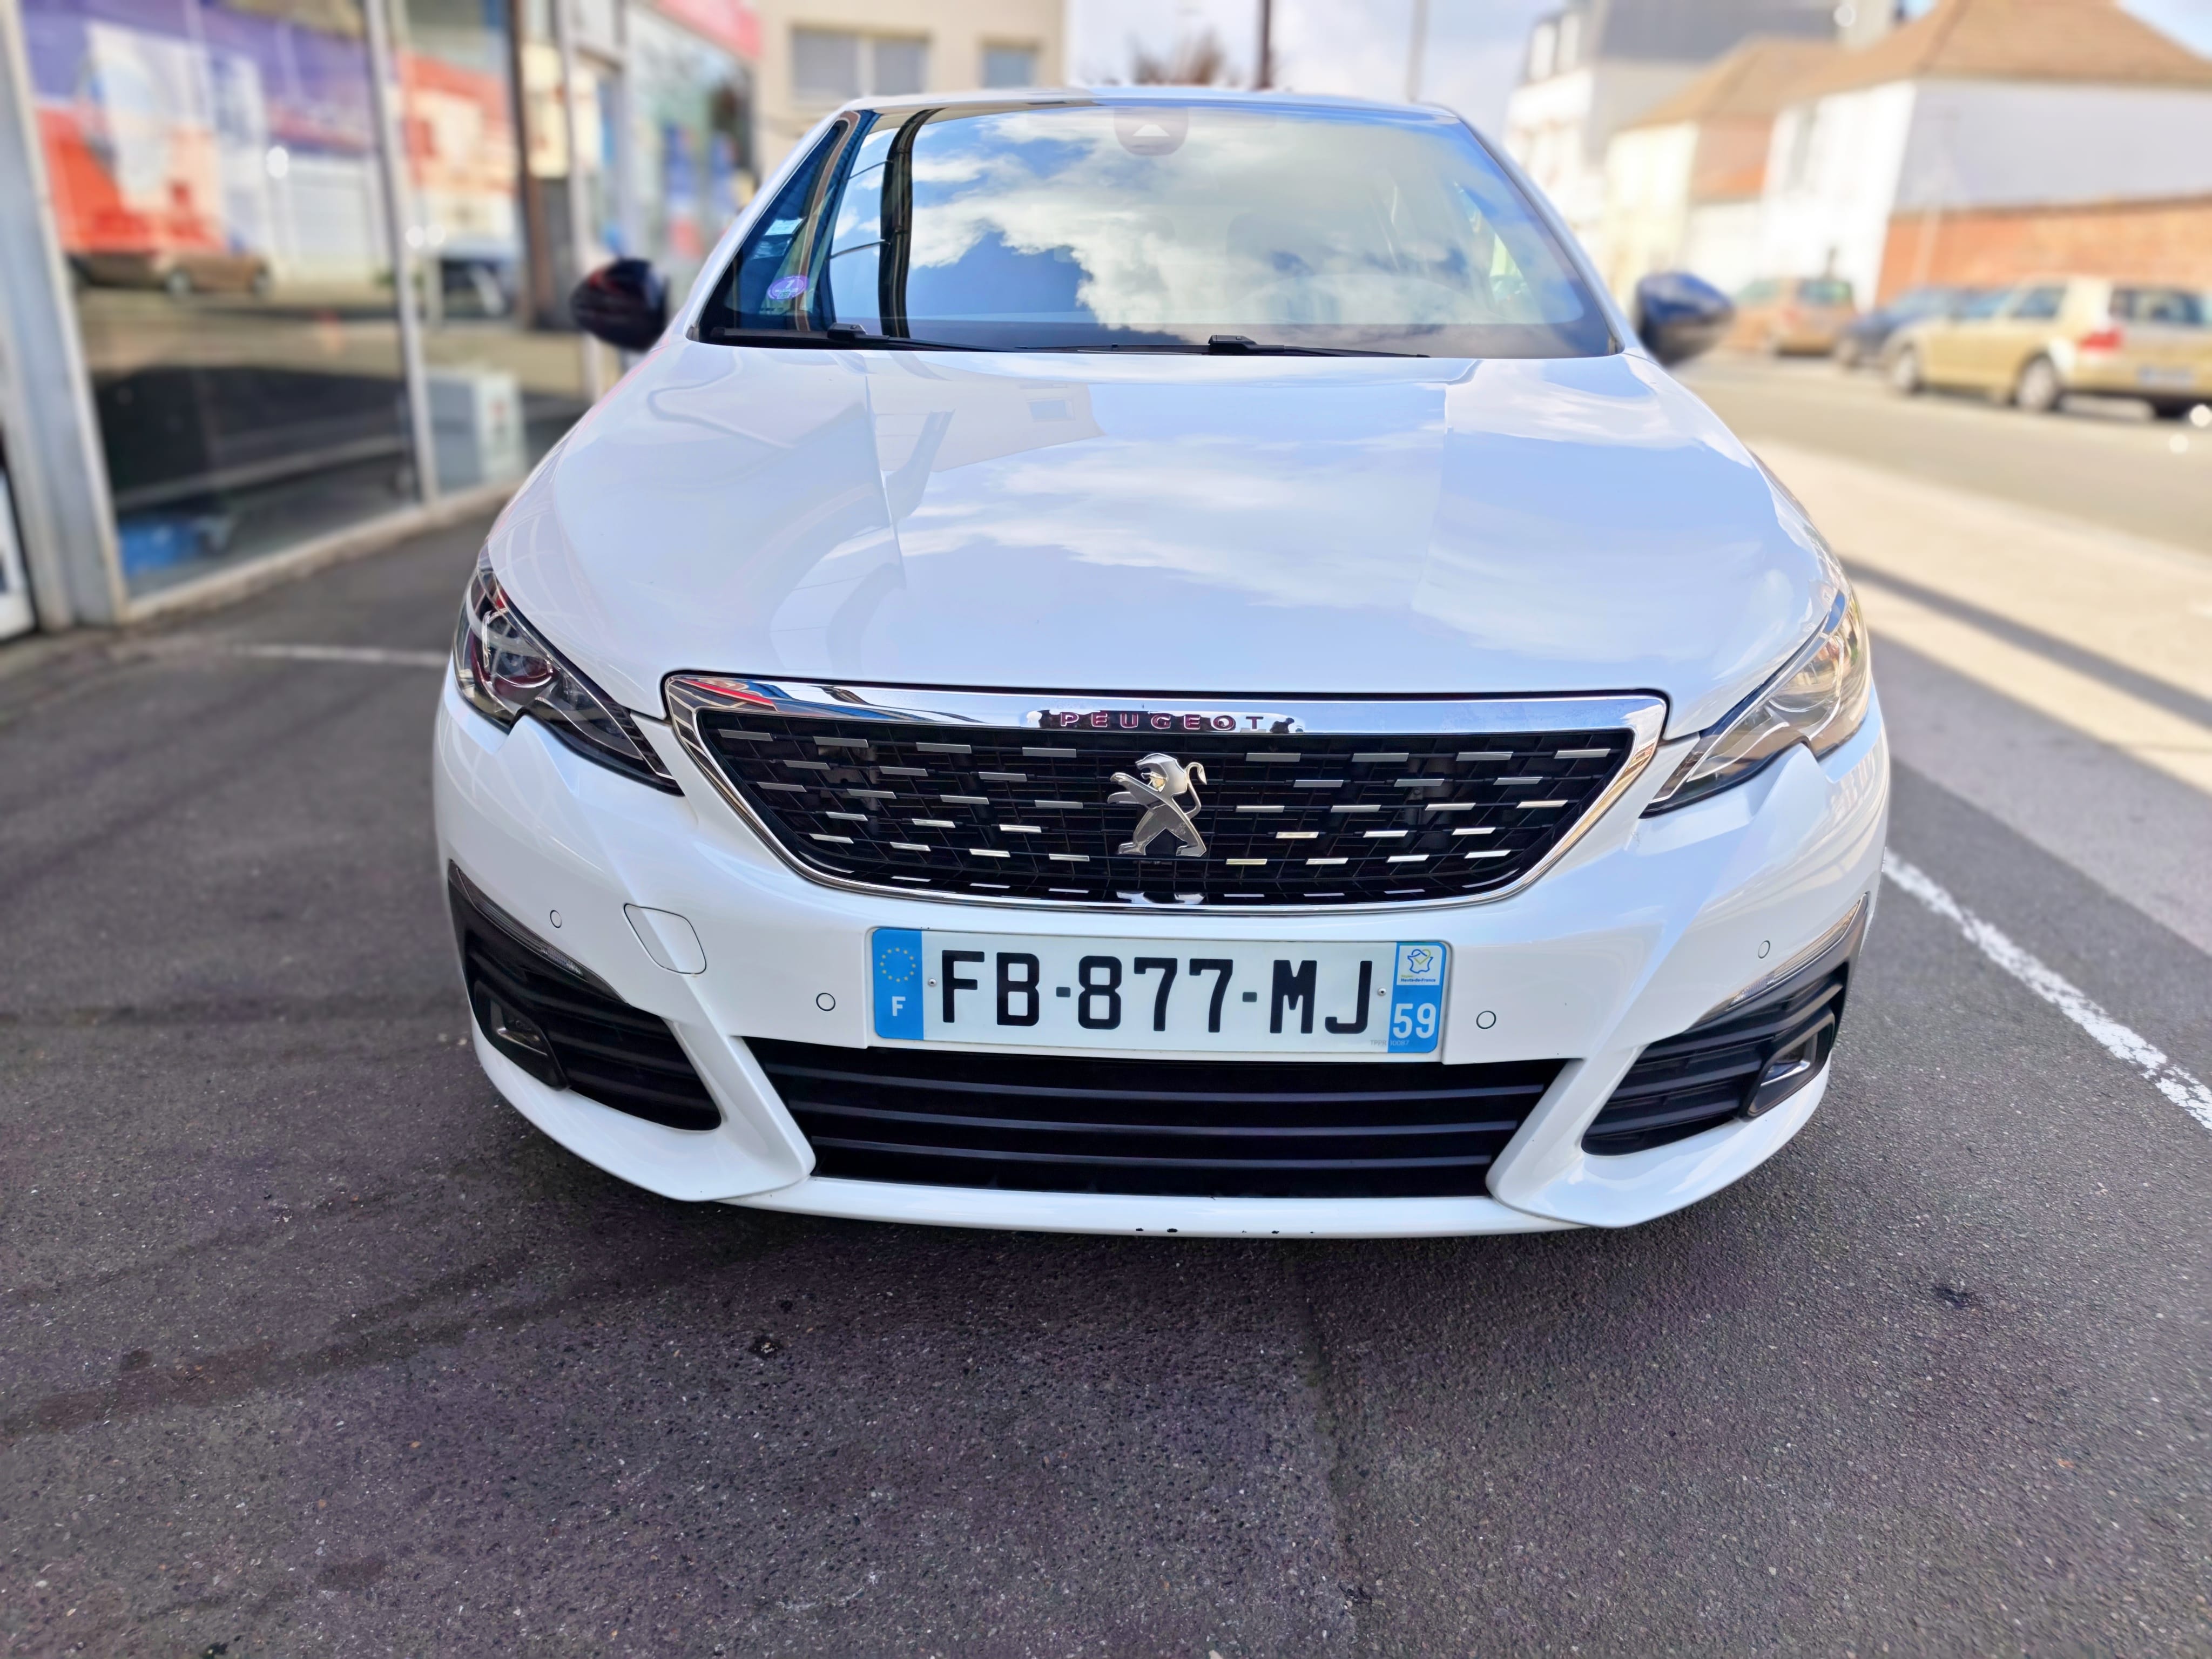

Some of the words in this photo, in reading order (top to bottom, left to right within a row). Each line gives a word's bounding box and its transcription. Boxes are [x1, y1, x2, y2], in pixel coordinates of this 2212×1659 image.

[1060, 711, 1264, 730] PEUGEOT
[942, 949, 1372, 1034] FB-877-MJ
[892, 996, 906, 1016] F
[1393, 1003, 1437, 1038] 59
